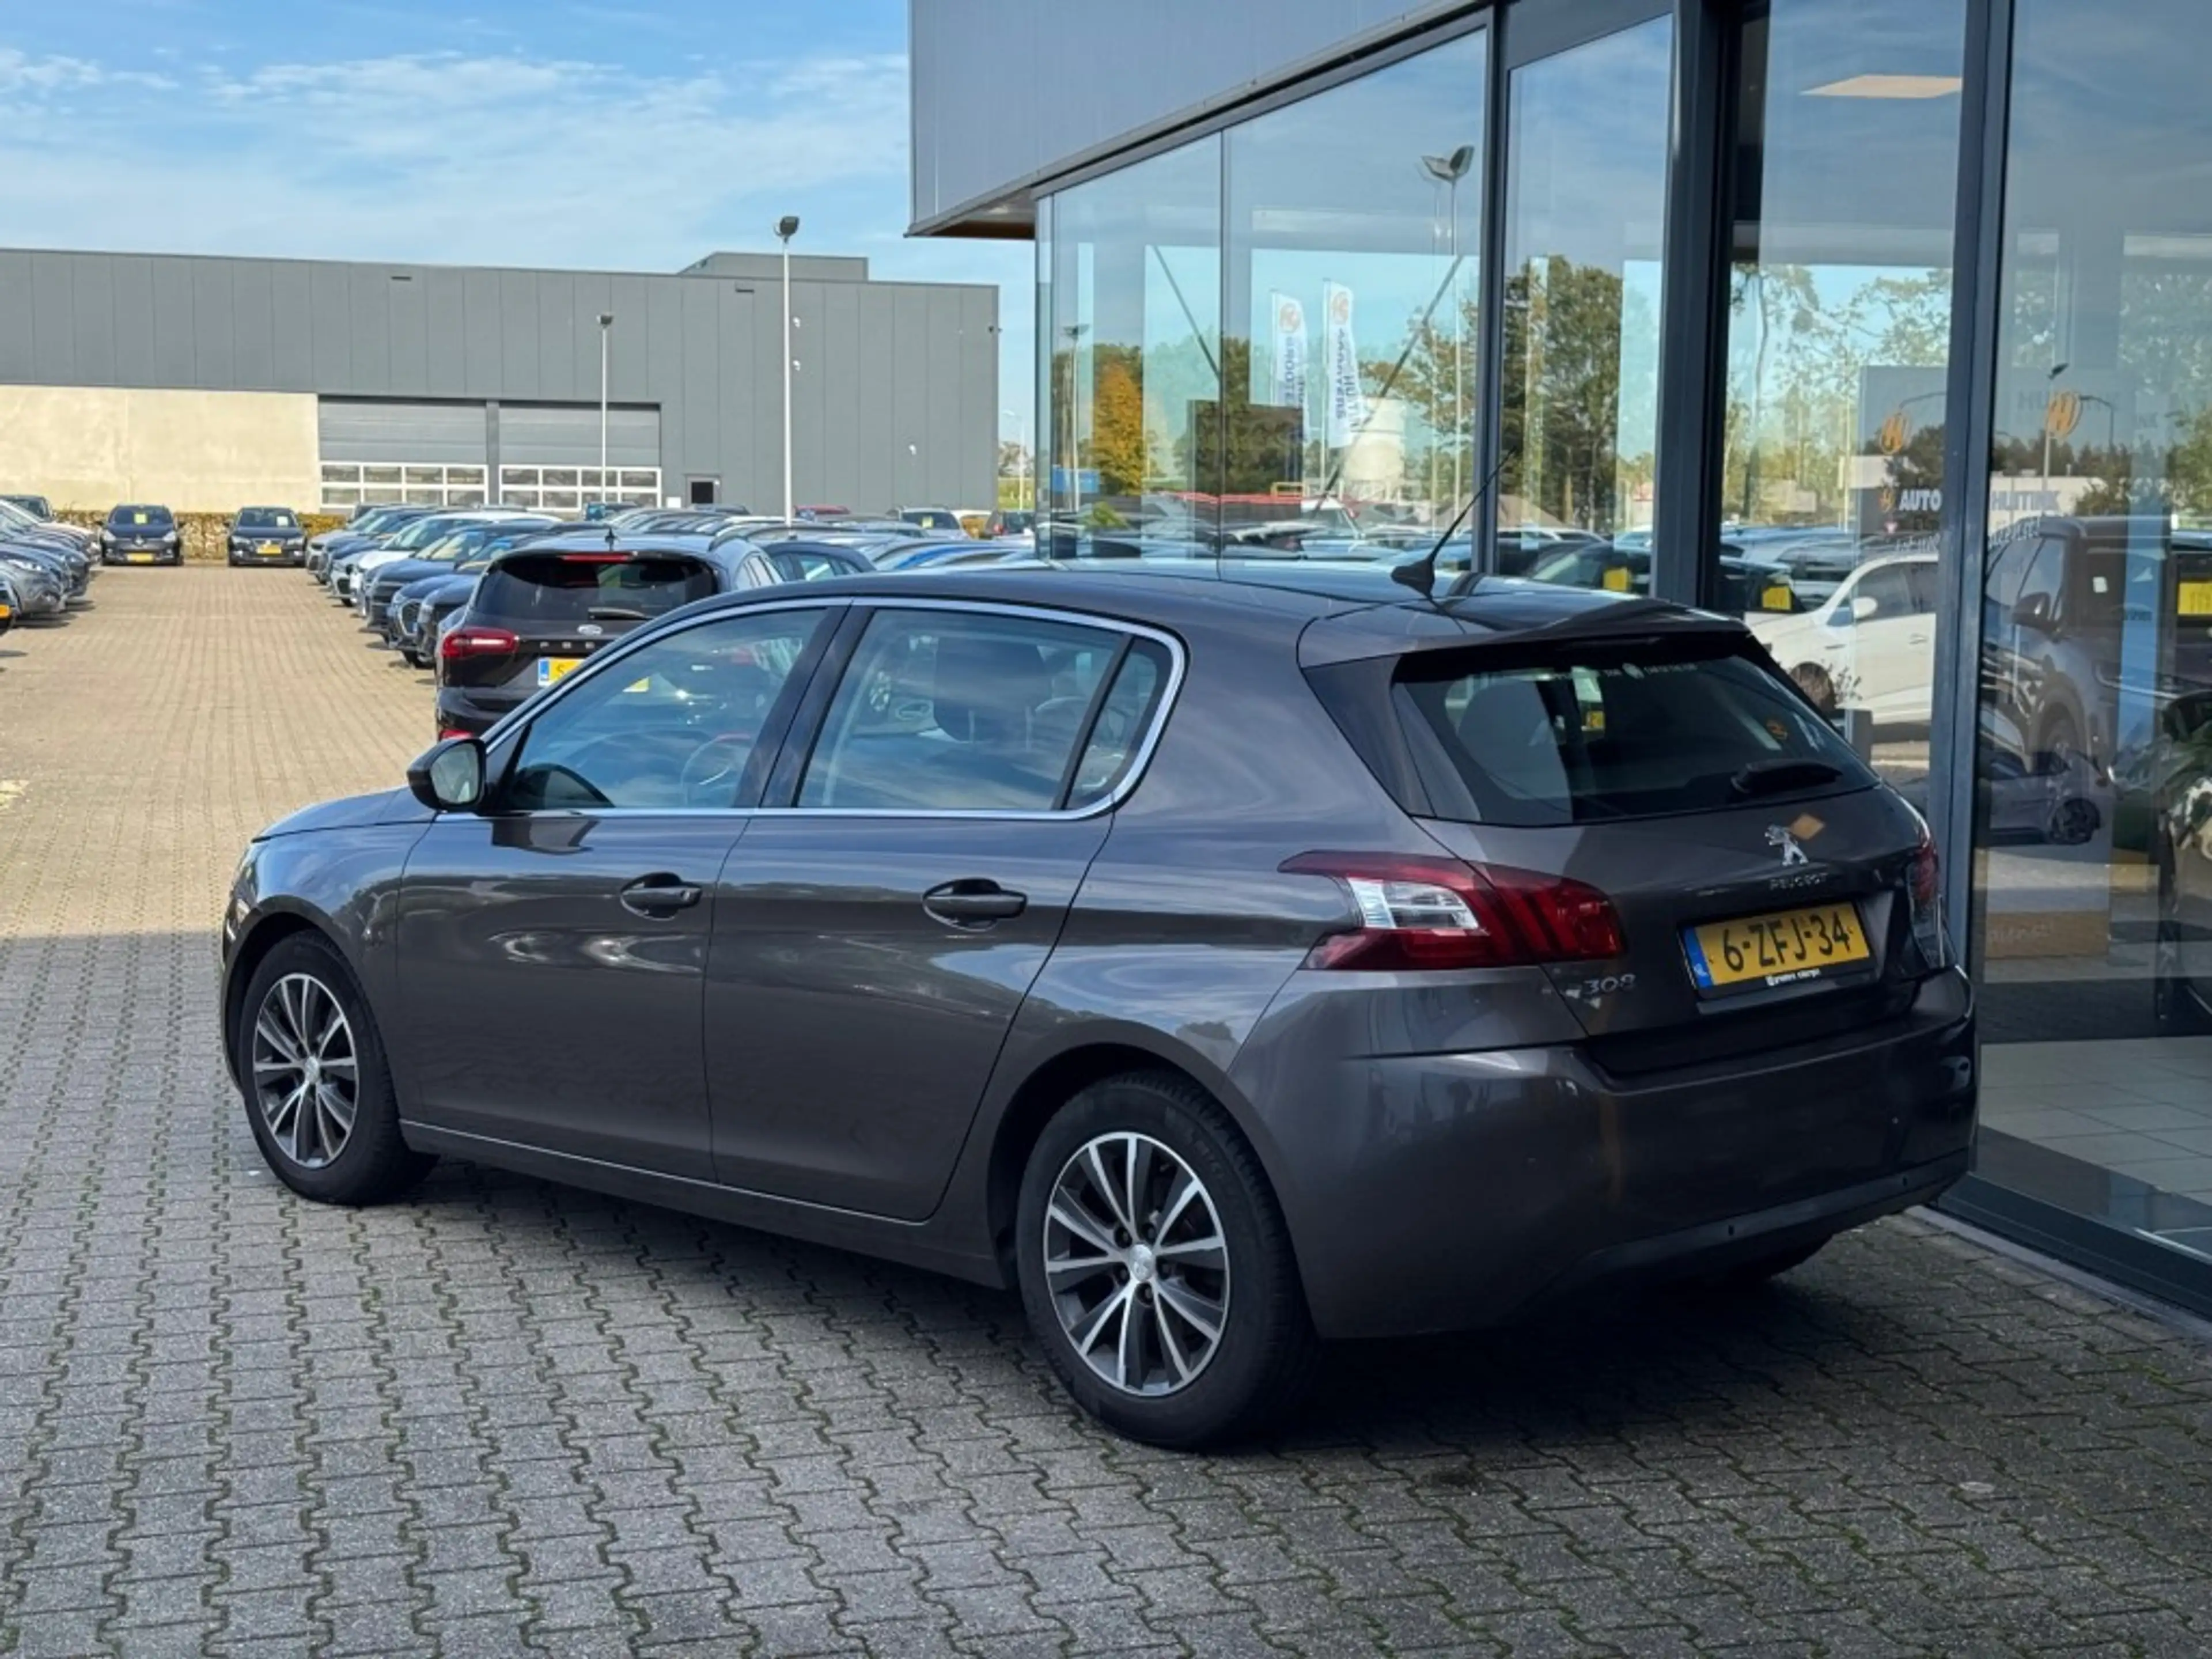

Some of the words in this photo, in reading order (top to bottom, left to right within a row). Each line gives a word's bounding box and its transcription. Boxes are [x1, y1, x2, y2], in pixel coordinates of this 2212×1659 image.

[1899, 489, 1942, 512] AUTO
[1722, 911, 1851, 972] 6-ZFJ-34
[1584, 973, 1636, 994] 308
